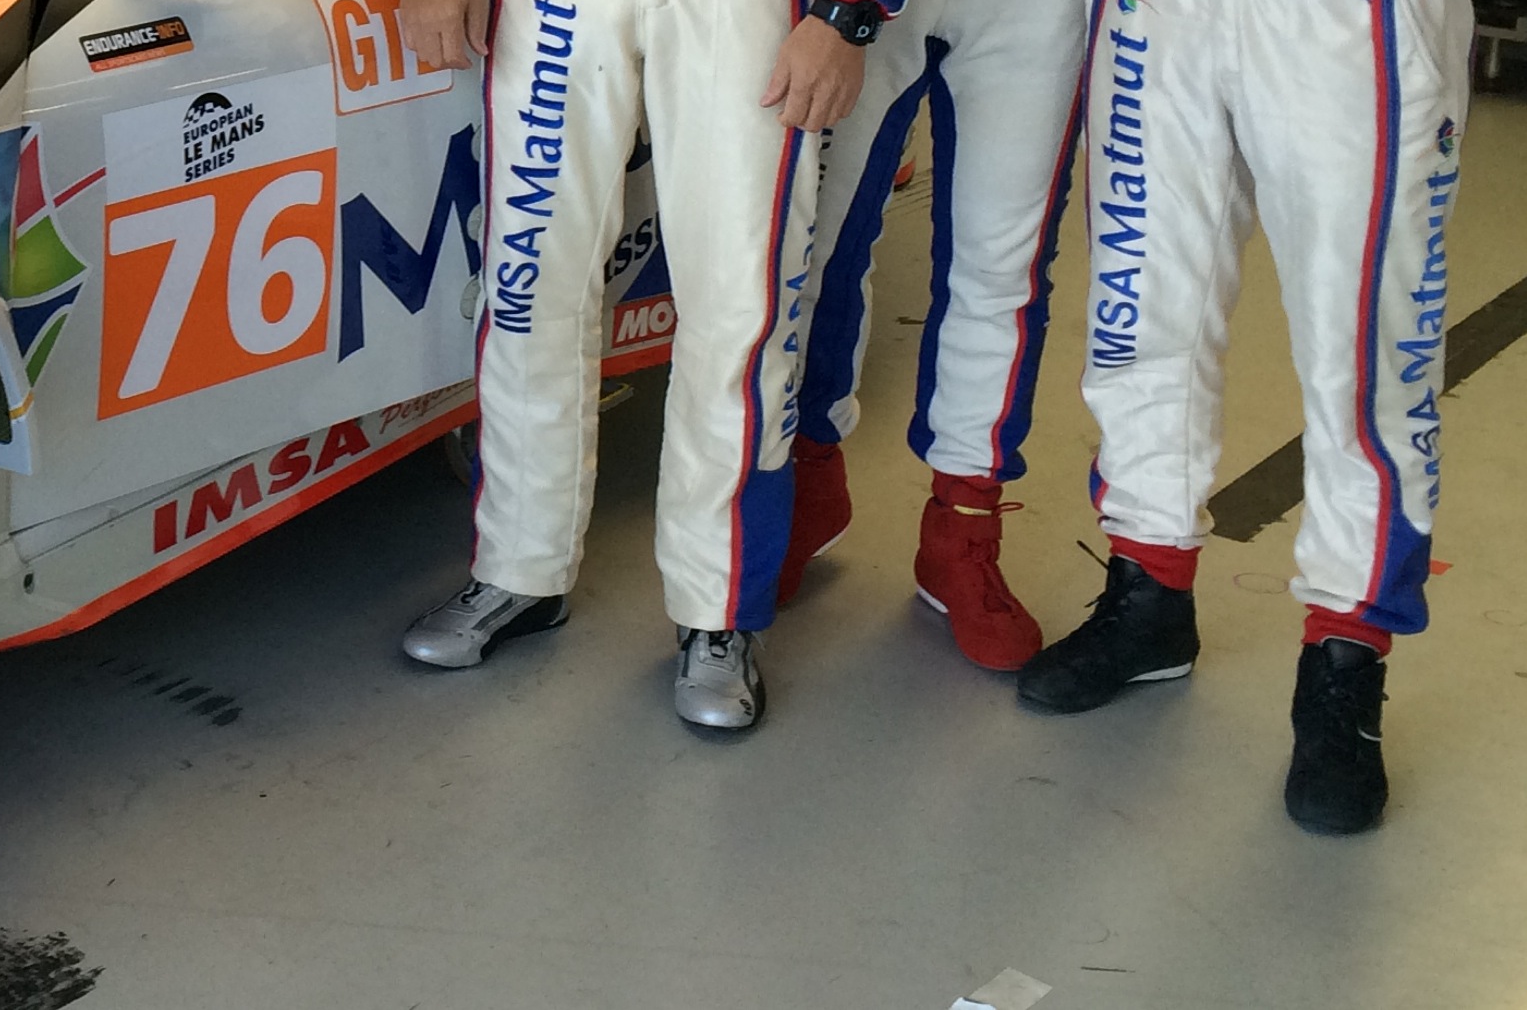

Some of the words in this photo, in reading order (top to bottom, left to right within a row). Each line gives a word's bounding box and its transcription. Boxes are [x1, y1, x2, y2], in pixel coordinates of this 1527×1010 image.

[83, 21, 185, 56] ENDURANCE-INFO
[183, 102, 254, 145] EUROPEAN
[183, 142, 206, 166] LE
[210, 112, 265, 154] MANS
[1098, 27, 1149, 258] Matmut
[184, 147, 235, 183] SERIES
[108, 169, 326, 401] 76
[494, 225, 548, 335] IMSA
[1092, 267, 1142, 369] IMSA
[616, 301, 675, 344] MO
[152, 417, 372, 554] IMSA
